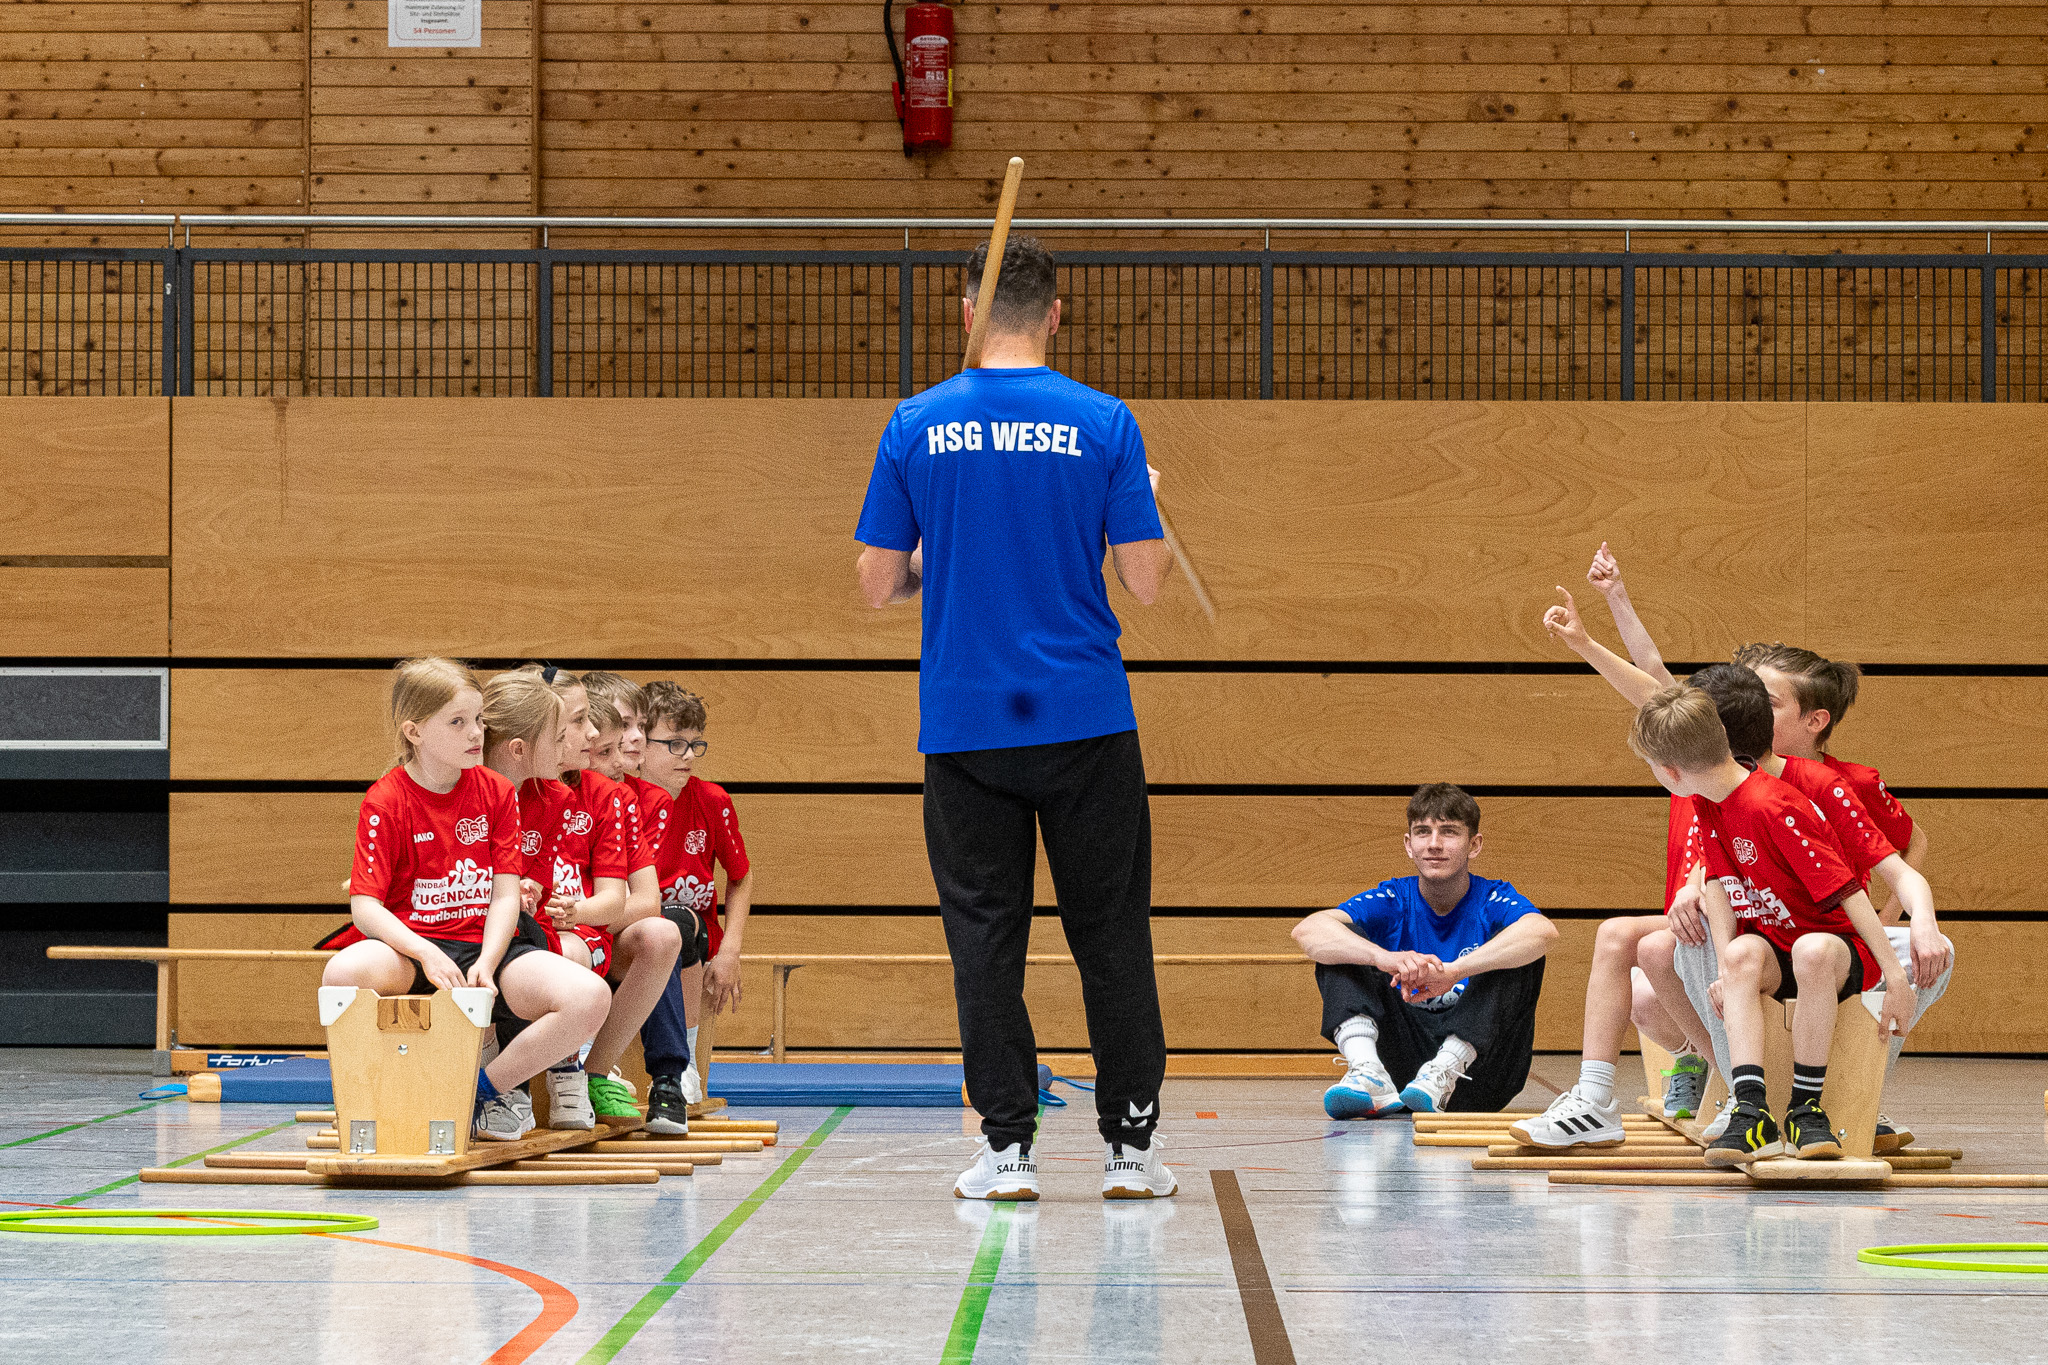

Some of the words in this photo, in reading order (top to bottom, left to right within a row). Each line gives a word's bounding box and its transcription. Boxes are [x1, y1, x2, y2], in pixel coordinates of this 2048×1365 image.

[927, 421, 982, 455] HSG
[991, 422, 1082, 457] WESEL
[996, 1163, 1038, 1175] SALMIN
[1105, 1161, 1145, 1173] ALMING
